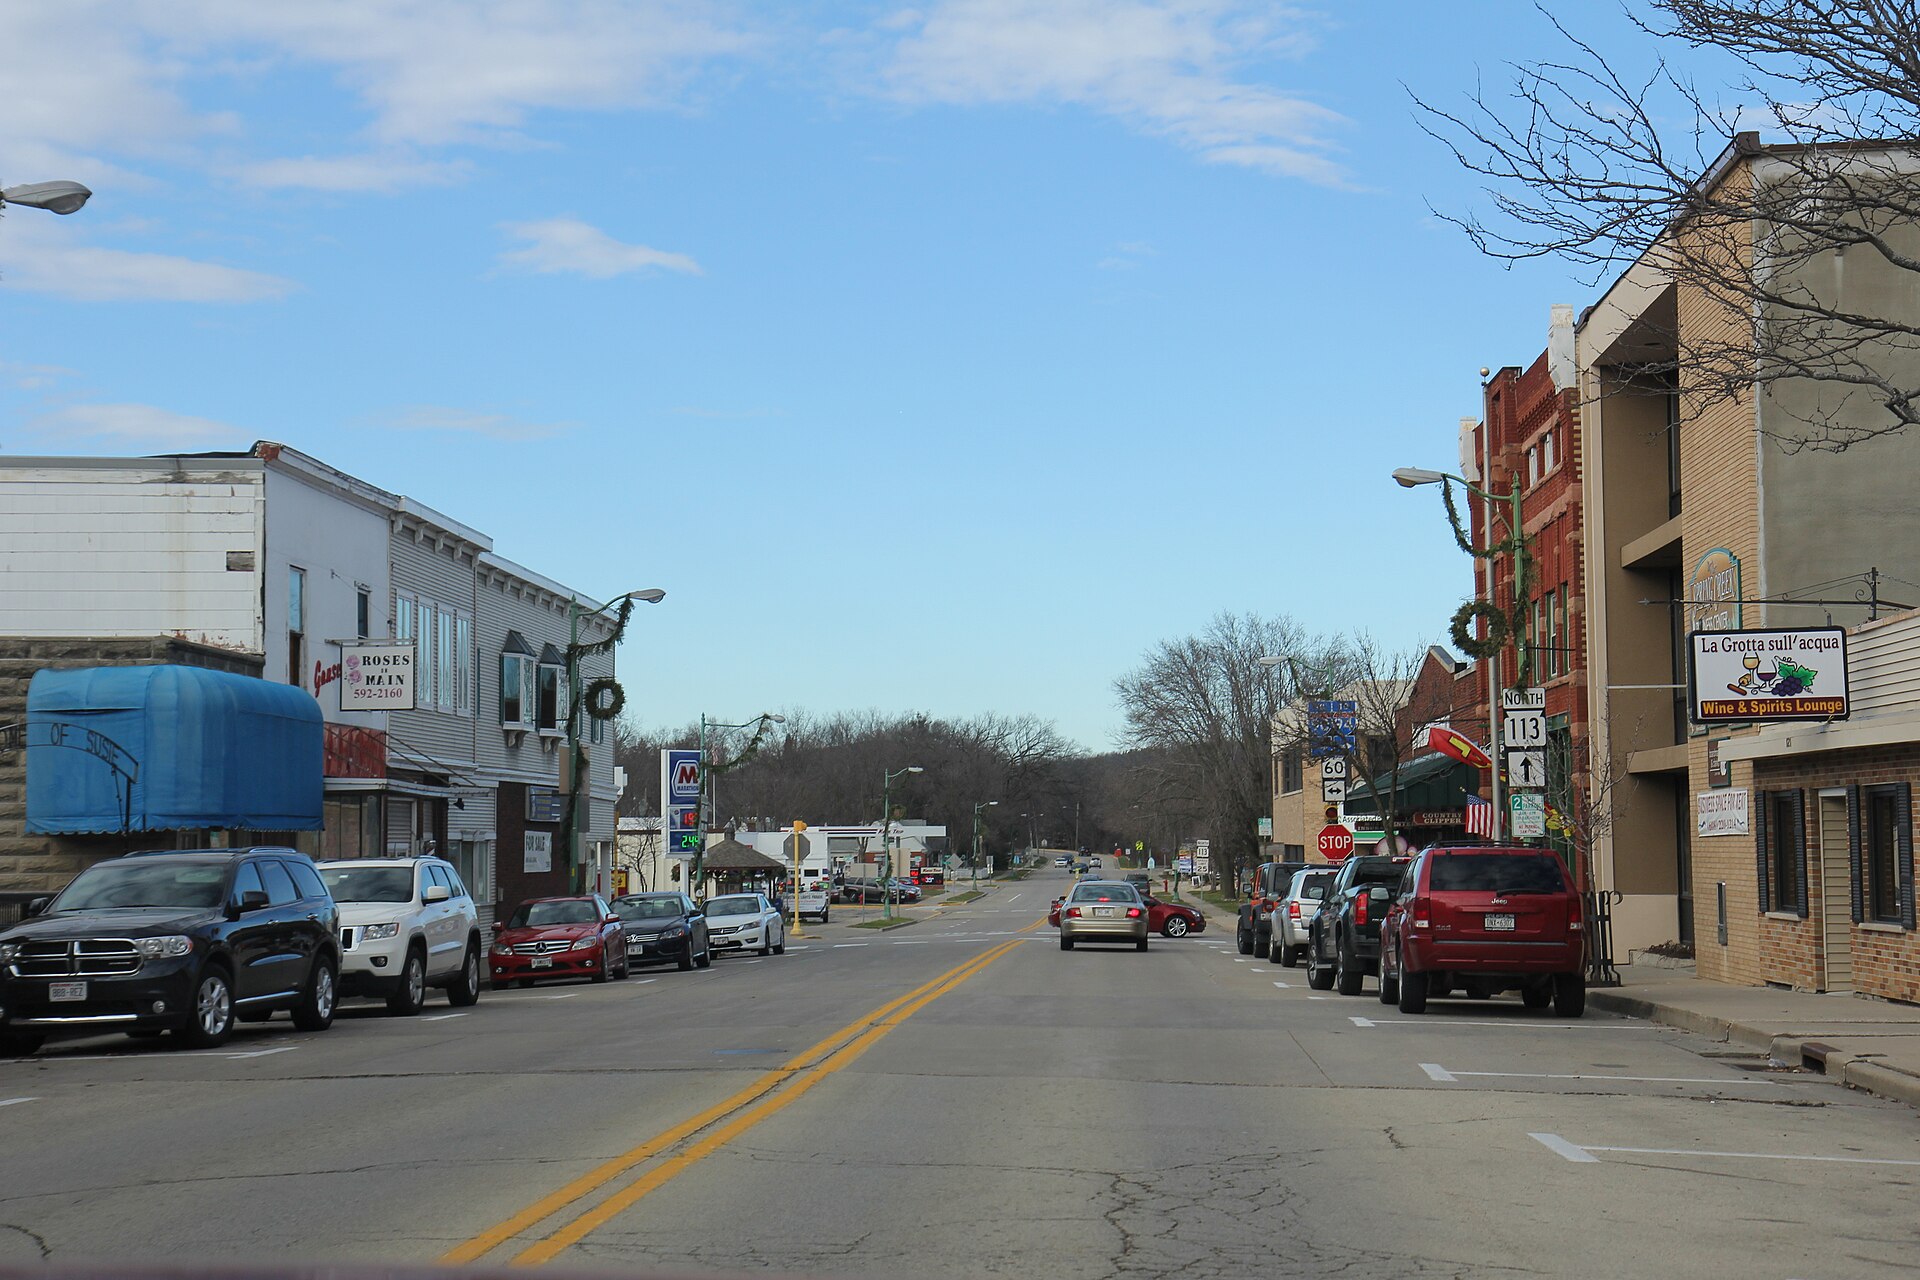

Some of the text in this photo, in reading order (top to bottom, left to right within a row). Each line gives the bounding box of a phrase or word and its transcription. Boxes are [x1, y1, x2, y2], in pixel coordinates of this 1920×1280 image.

[1701, 638, 1718, 653] La
[1721, 637, 1765, 652] Grotta
[362, 655, 410, 666] ROSES
[365, 675, 405, 686] MAIN
[353, 688, 403, 699] 592-2160
[1504, 692, 1543, 705] NORTH
[1702, 699, 1843, 716] Wine & Spirits Lounge
[1510, 717, 1540, 740] 113
[51, 723, 69, 746] OF
[86, 729, 119, 763] SUSIE
[1324, 761, 1344, 774] 60
[1514, 797, 1521, 809] 2
[526, 835, 546, 852] FOR SALE
[1320, 835, 1351, 849] STOP
[1198, 848, 1208, 856] 113
